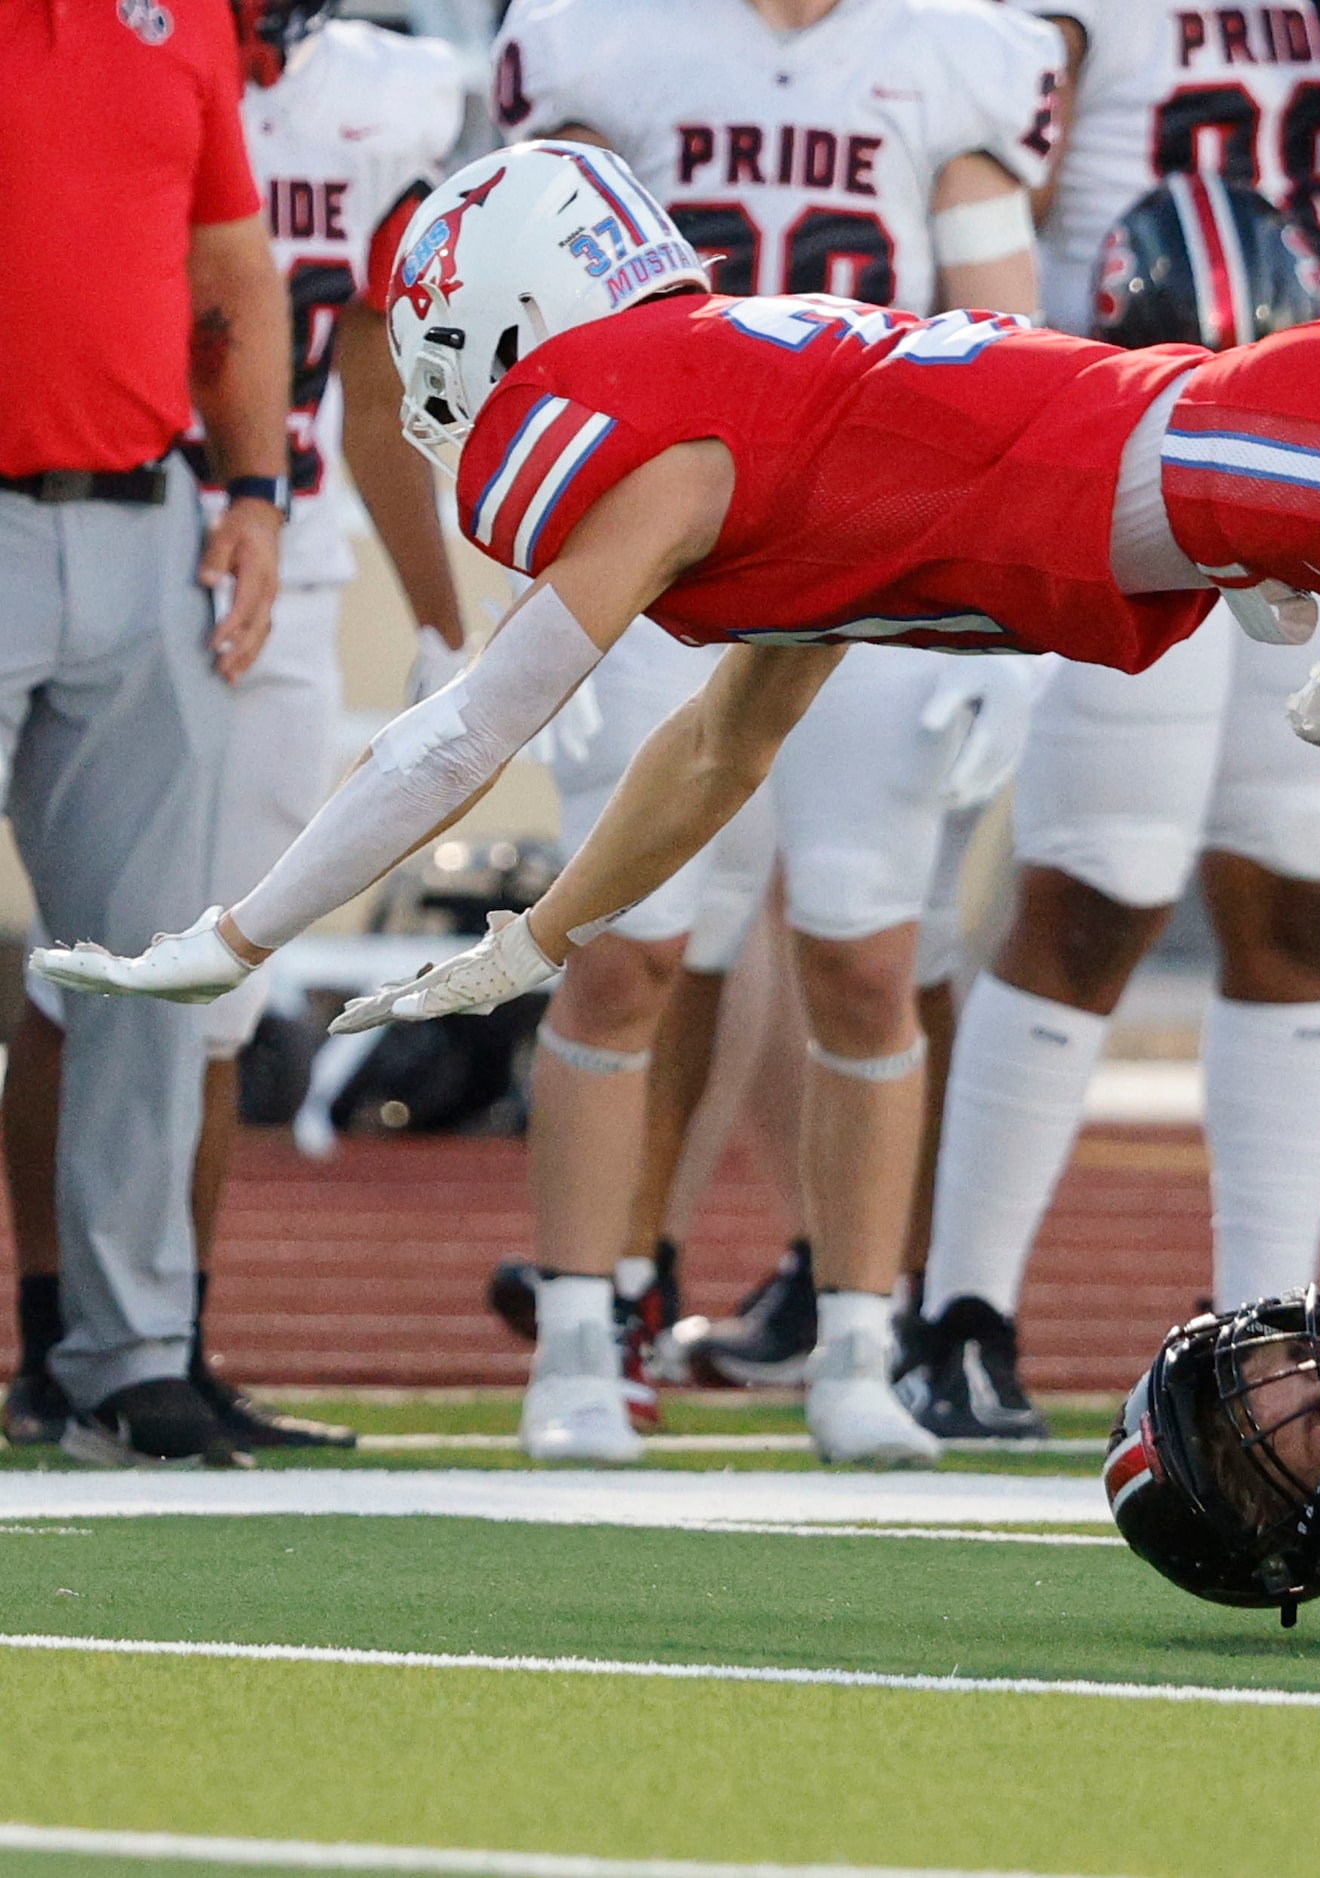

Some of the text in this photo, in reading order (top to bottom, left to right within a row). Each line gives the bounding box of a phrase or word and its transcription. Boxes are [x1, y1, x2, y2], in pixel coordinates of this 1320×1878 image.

[1176, 8, 1314, 67] PRID
[679, 124, 882, 196] PRIDE
[569, 216, 627, 278] 37
